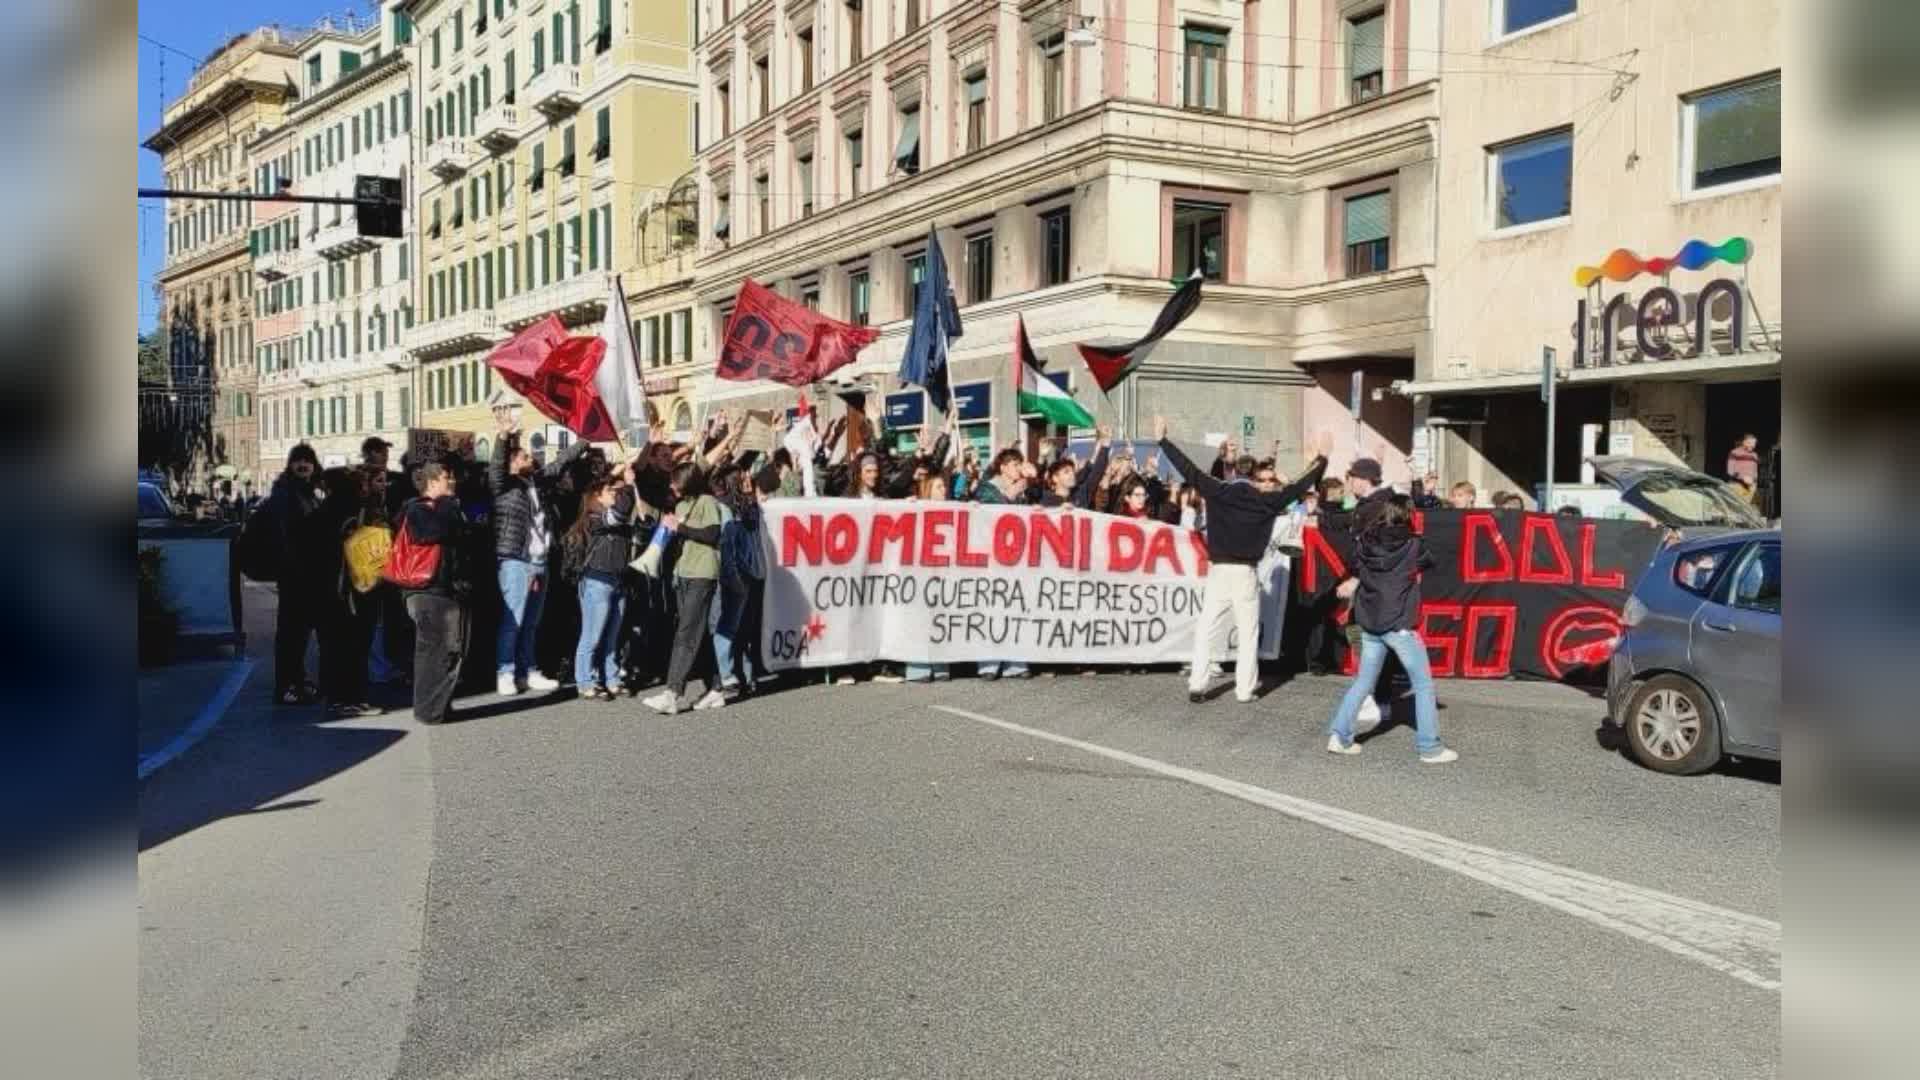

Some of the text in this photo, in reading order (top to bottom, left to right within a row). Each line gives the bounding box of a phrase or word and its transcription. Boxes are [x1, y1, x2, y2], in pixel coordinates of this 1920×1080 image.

[1576, 278, 1744, 368] iren
[783, 513, 859, 566] NO
[868, 511, 1092, 571] MELONI
[1464, 513, 1625, 589] DDL
[814, 574, 1206, 616] CONTRO GUERRA, REPRESSION
[771, 629, 809, 660] OSA
[929, 612, 1167, 648] SFRUTTAMENTO
